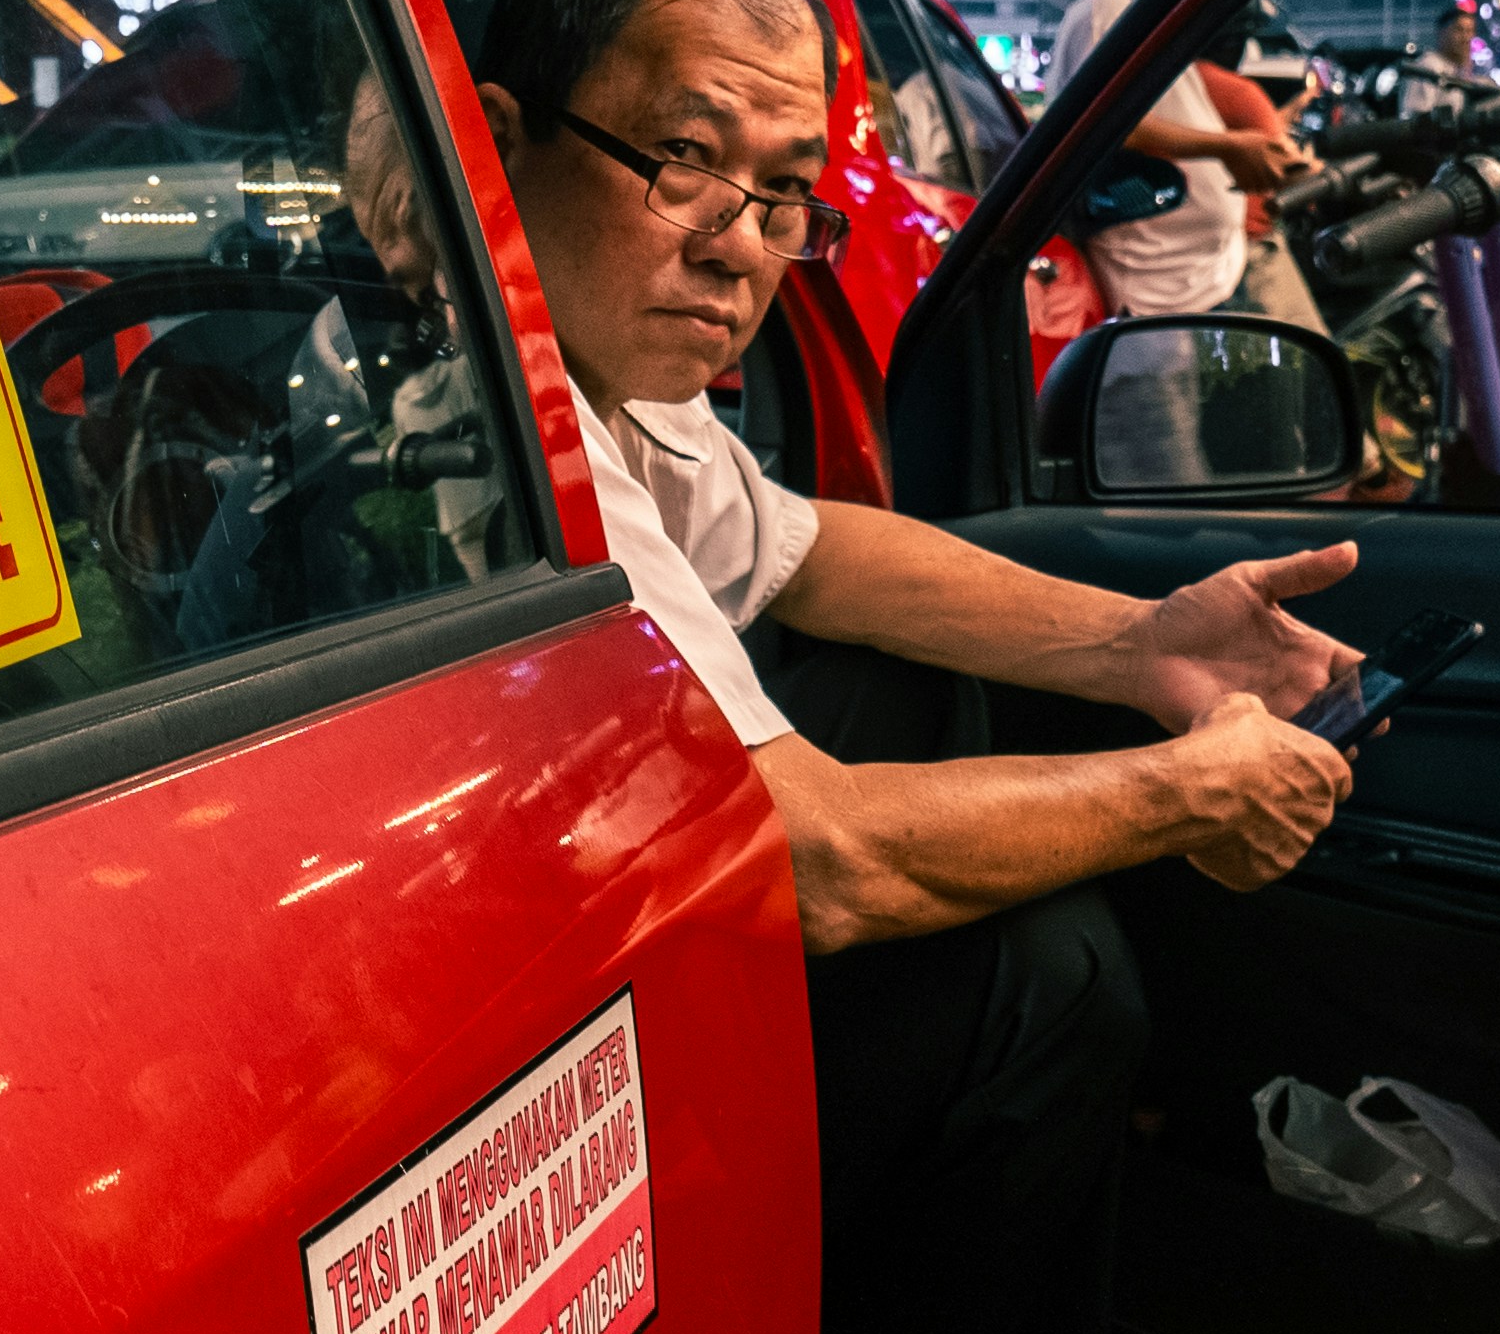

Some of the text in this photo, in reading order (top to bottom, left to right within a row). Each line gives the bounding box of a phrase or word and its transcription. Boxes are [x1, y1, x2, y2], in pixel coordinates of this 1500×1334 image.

[401, 1186, 437, 1284] INI
[436, 1069, 580, 1251] MENGGUNAKAN
[577, 1024, 631, 1125] METER
[547, 1098, 638, 1249] DILARANG
